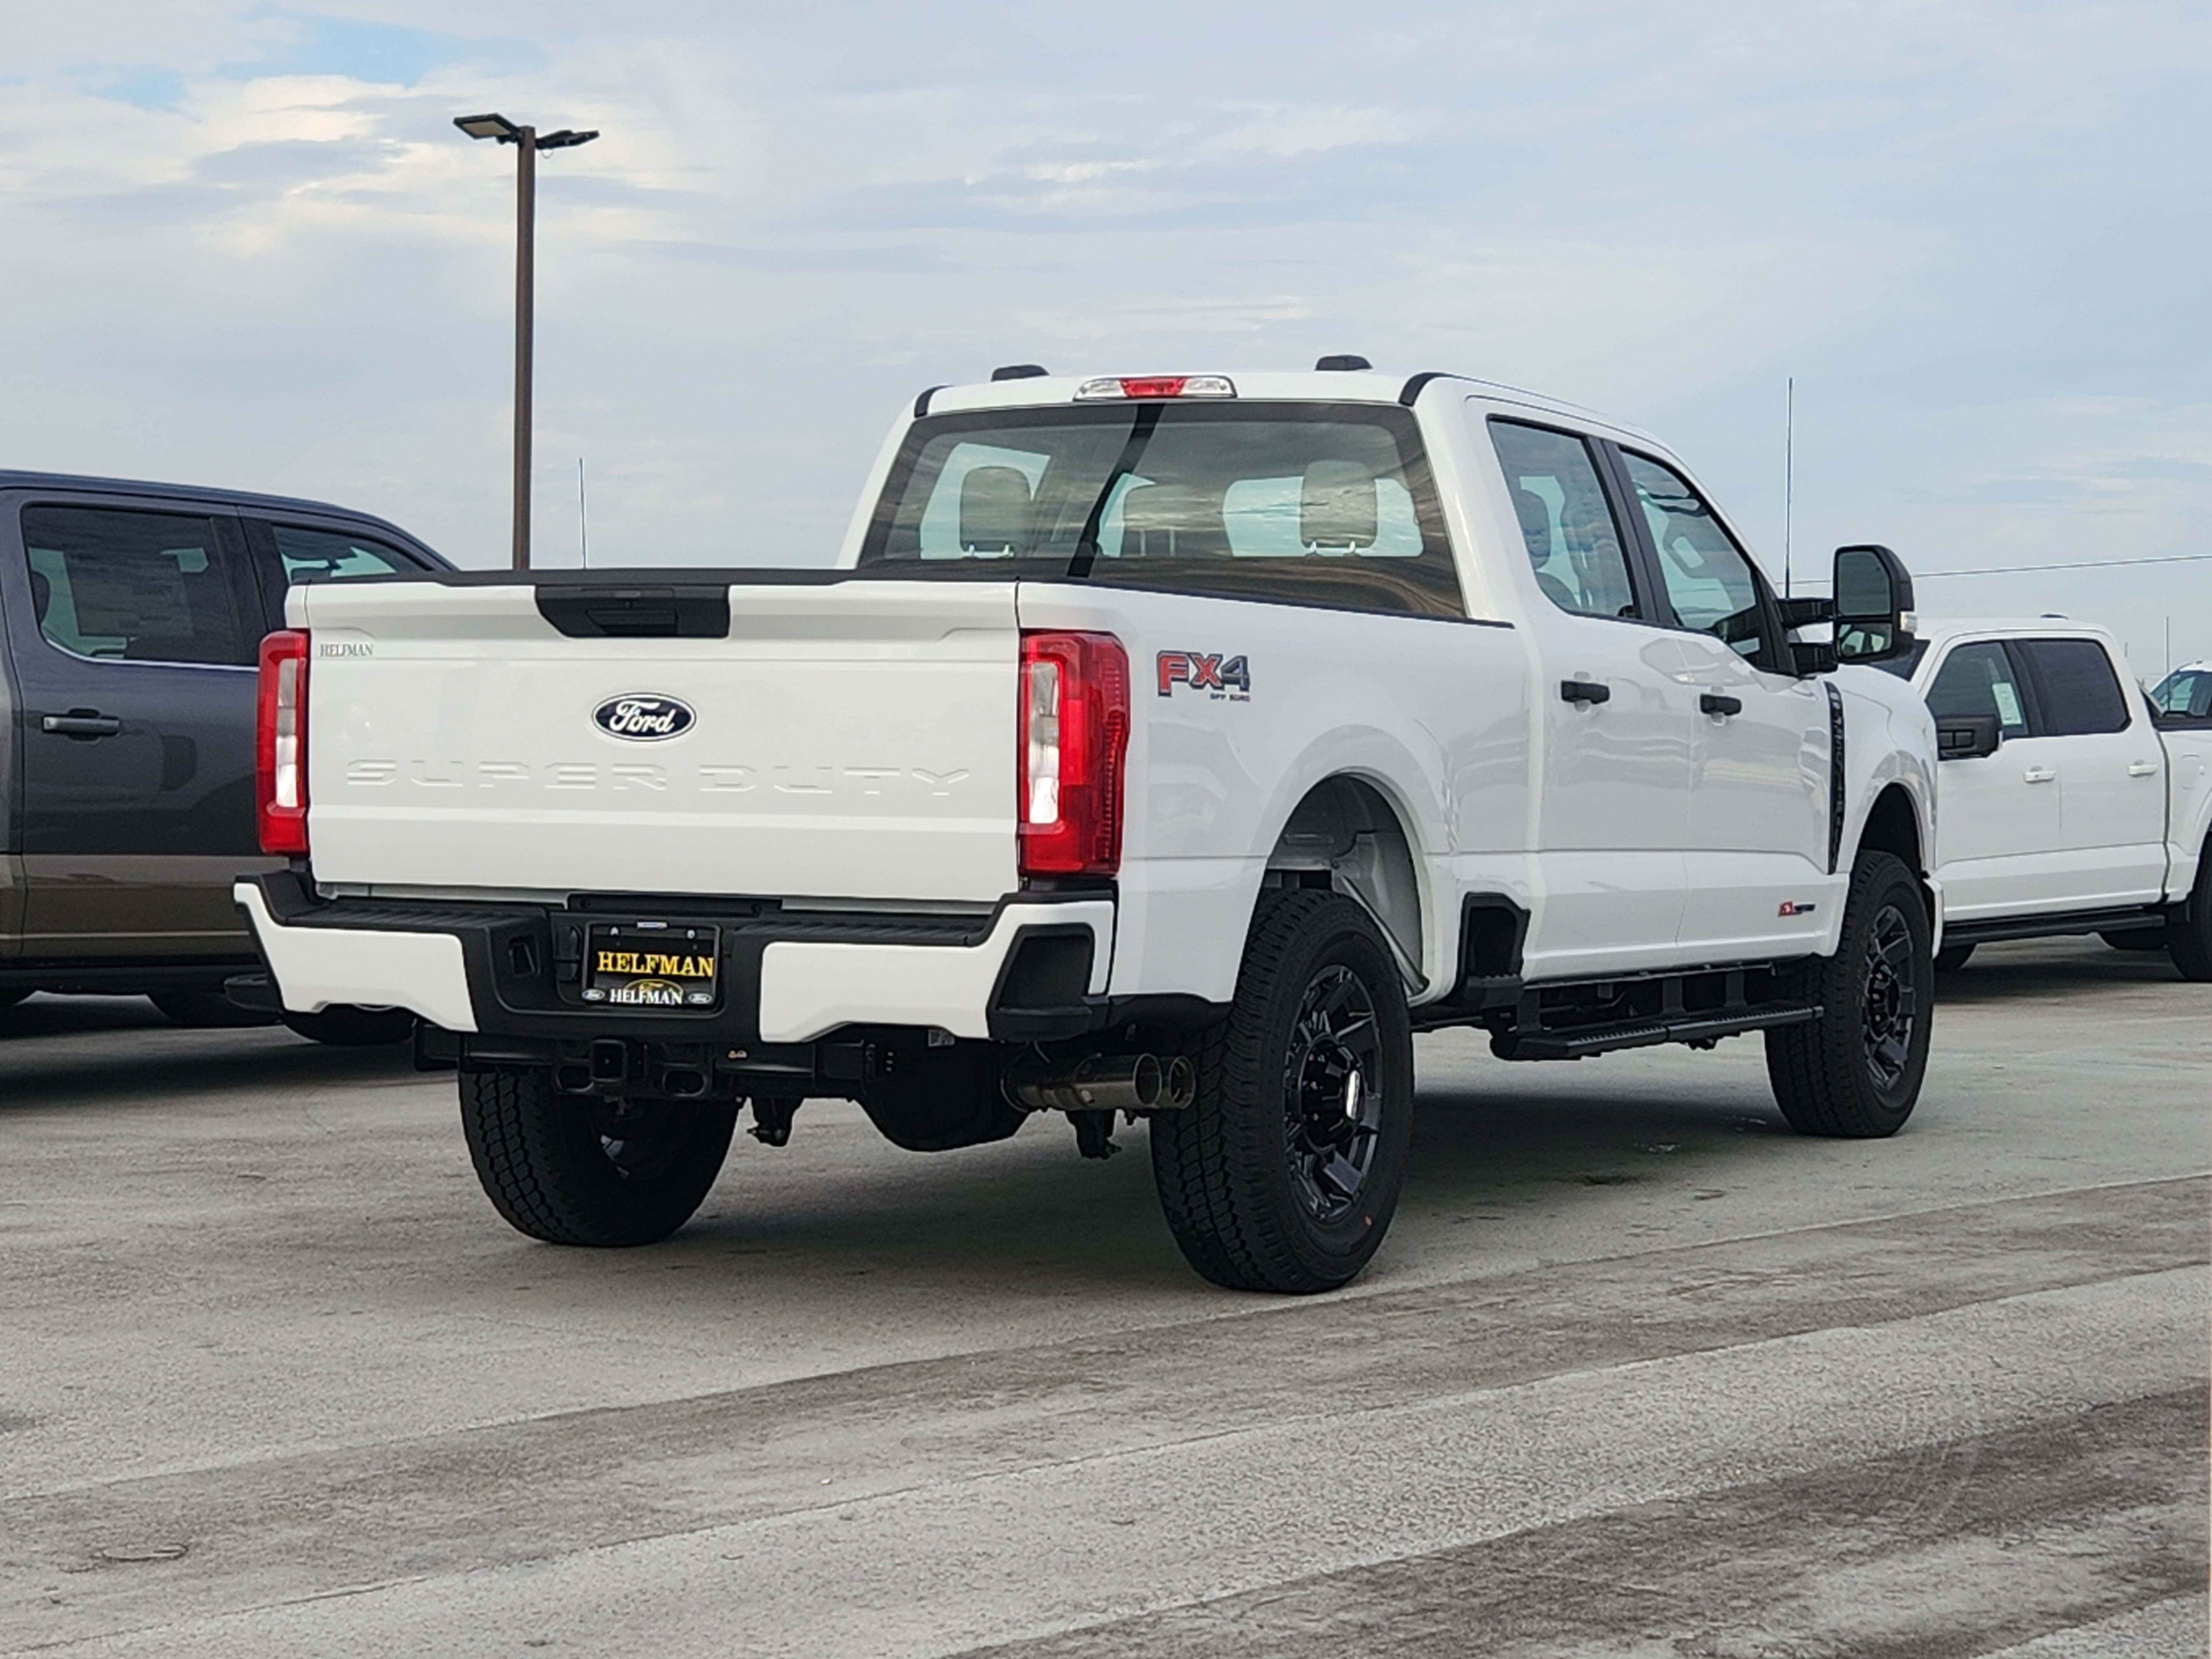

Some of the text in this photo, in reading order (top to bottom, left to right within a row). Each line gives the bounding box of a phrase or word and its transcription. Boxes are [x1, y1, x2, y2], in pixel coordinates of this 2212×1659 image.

[320, 643, 373, 657] HELFMAN
[1157, 650, 1250, 697] FX4
[609, 700, 676, 732] Ford
[347, 758, 970, 797] SUPER DUTY
[596, 950, 715, 978] HELFMAN
[609, 988, 683, 1005] HELFMAN
